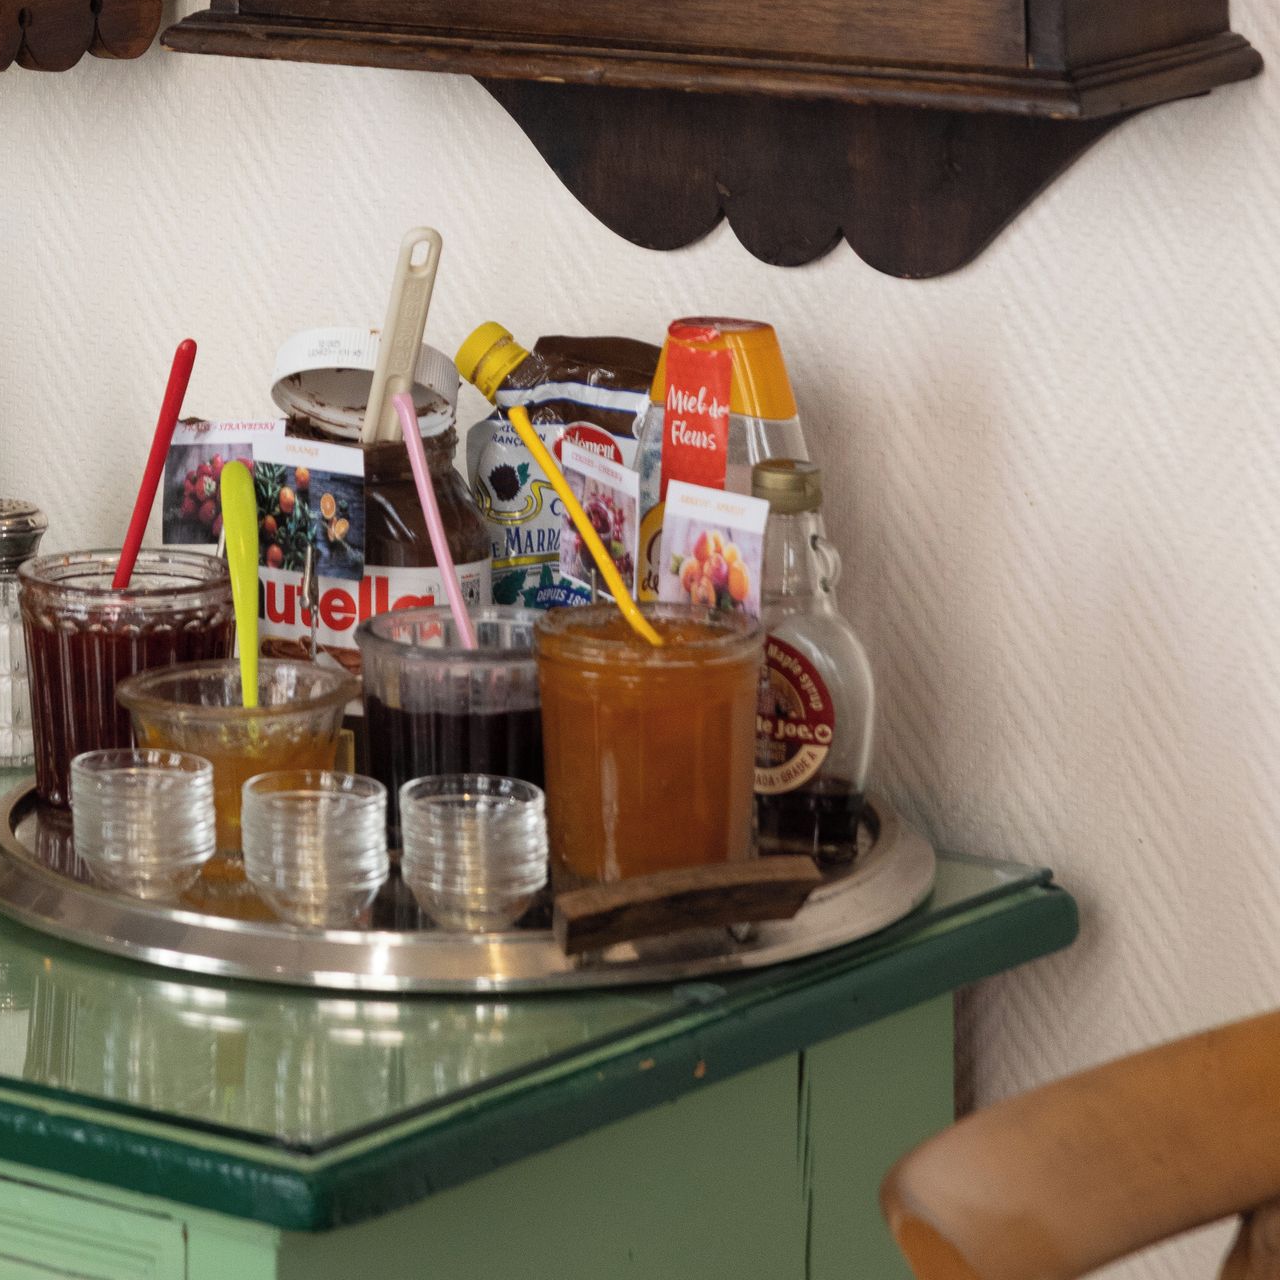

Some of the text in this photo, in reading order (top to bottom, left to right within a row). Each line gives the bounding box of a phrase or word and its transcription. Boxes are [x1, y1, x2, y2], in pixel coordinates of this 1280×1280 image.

[667, 383, 706, 415] Miel
[671, 419, 717, 450] Fleurs
[537, 589, 567, 603] DEPUIS
[767, 642, 825, 712] Maple syrup
